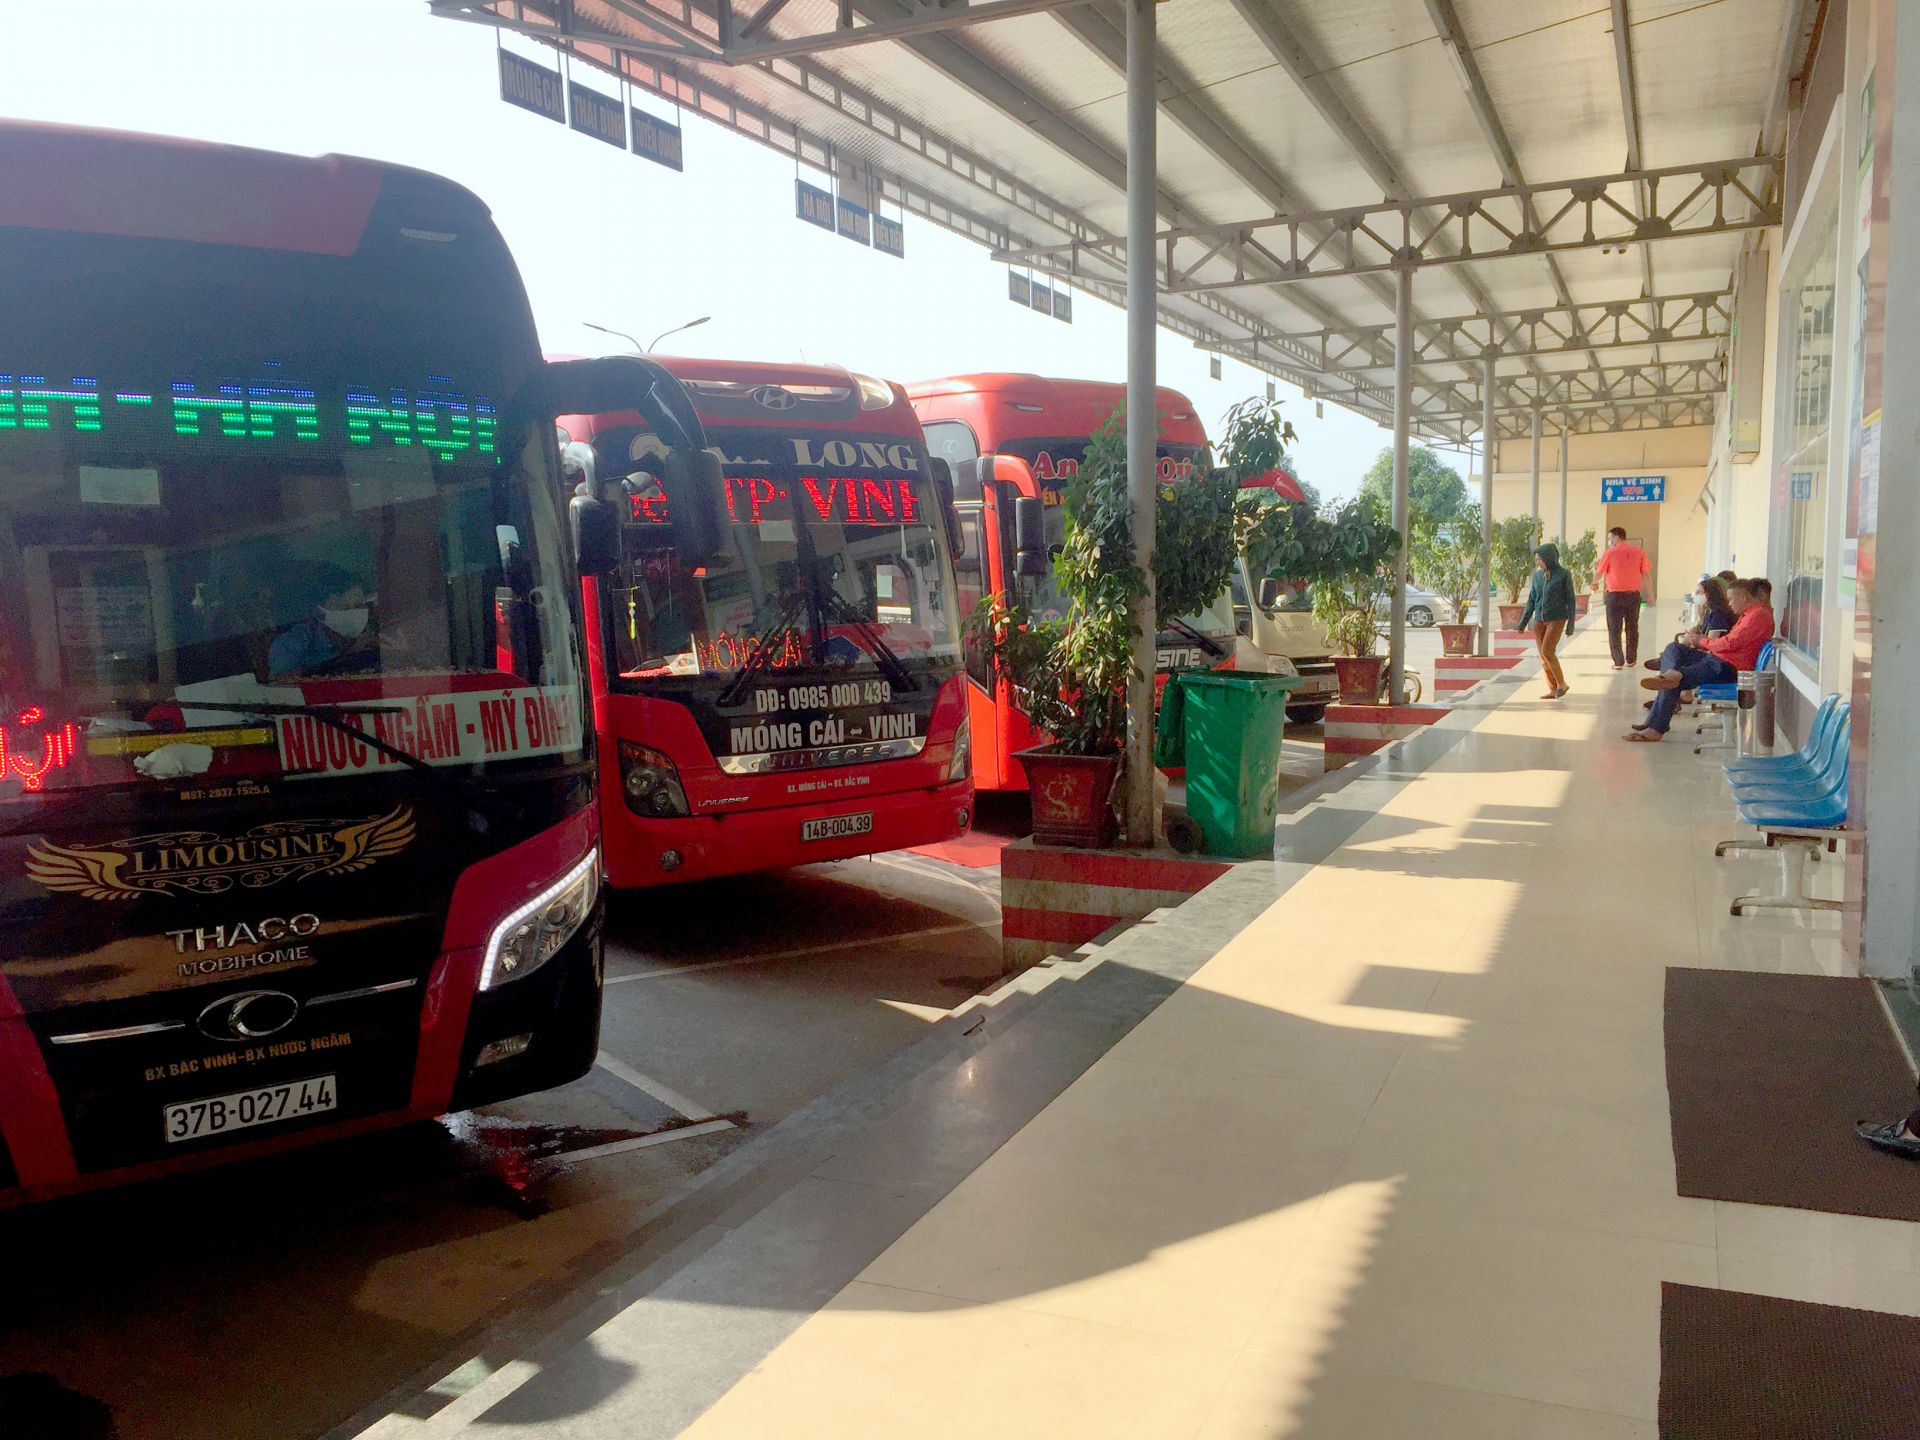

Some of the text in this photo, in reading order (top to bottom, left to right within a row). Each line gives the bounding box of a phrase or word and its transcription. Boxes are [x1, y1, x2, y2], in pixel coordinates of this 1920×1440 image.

[573, 92, 599, 131] THÁI
[802, 189, 832, 227] HÀ NỘI
[789, 438, 918, 472] LONG
[1605, 478, 1625, 486] NHÀ
[1639, 477, 1661, 485] SINH
[1621, 486, 1644, 495] WC
[789, 686, 828, 710] 0985
[831, 683, 860, 707] 000
[864, 681, 891, 704] 439
[480, 689, 519, 753] MỸ
[730, 712, 917, 754] MÓNG CÁI VINH
[805, 816, 871, 839] 14B-004.39
[134, 832, 335, 873] LIMOUSINE
[165, 913, 320, 953] THACO
[177, 946, 310, 977] MOBIHOME
[145, 1066, 166, 1082] BX
[171, 1079, 333, 1138] 37B-027.44
